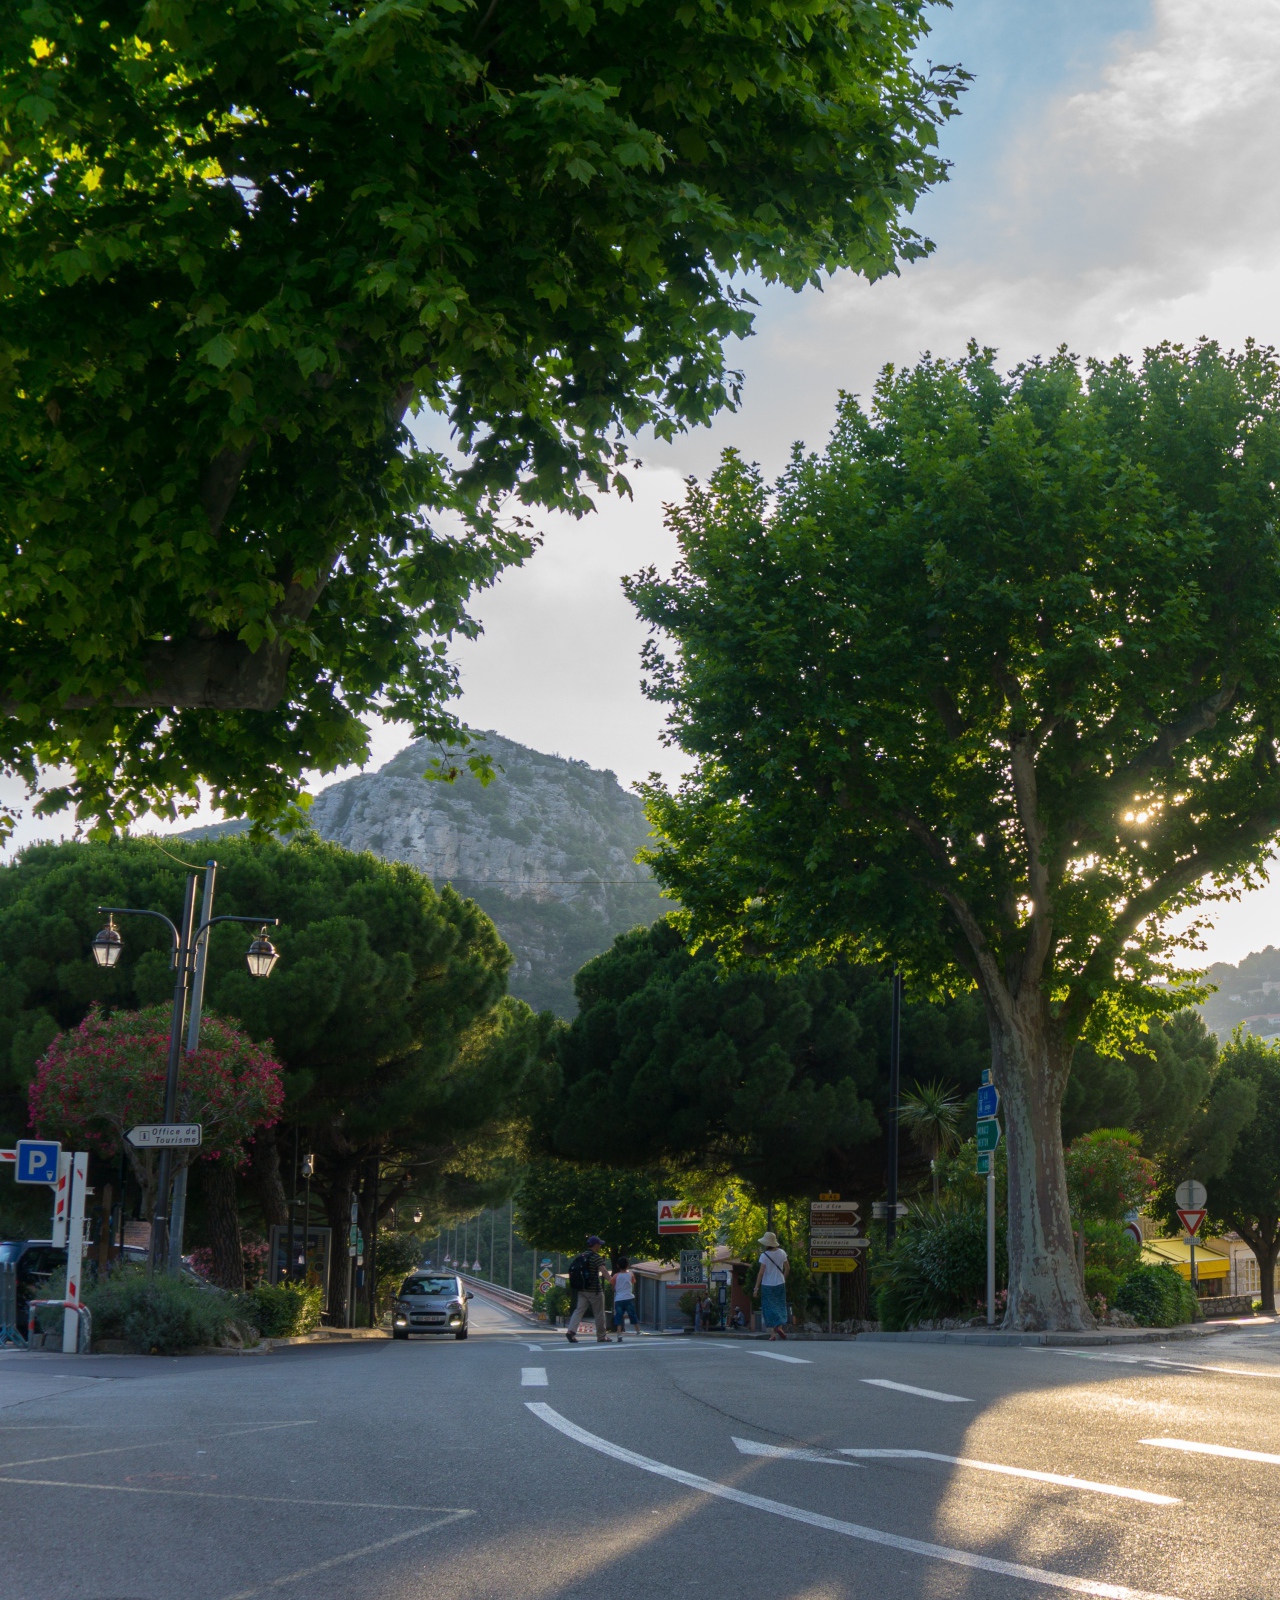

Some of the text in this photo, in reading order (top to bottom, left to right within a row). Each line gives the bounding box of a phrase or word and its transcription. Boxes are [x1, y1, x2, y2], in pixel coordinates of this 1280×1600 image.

[155, 1136, 196, 1144] Tourisme
[28, 1151, 47, 1174] P
[659, 1205, 701, 1219] AIA
[684, 1265, 700, 1273] 1.56
[684, 1276, 700, 1284] 1.39
